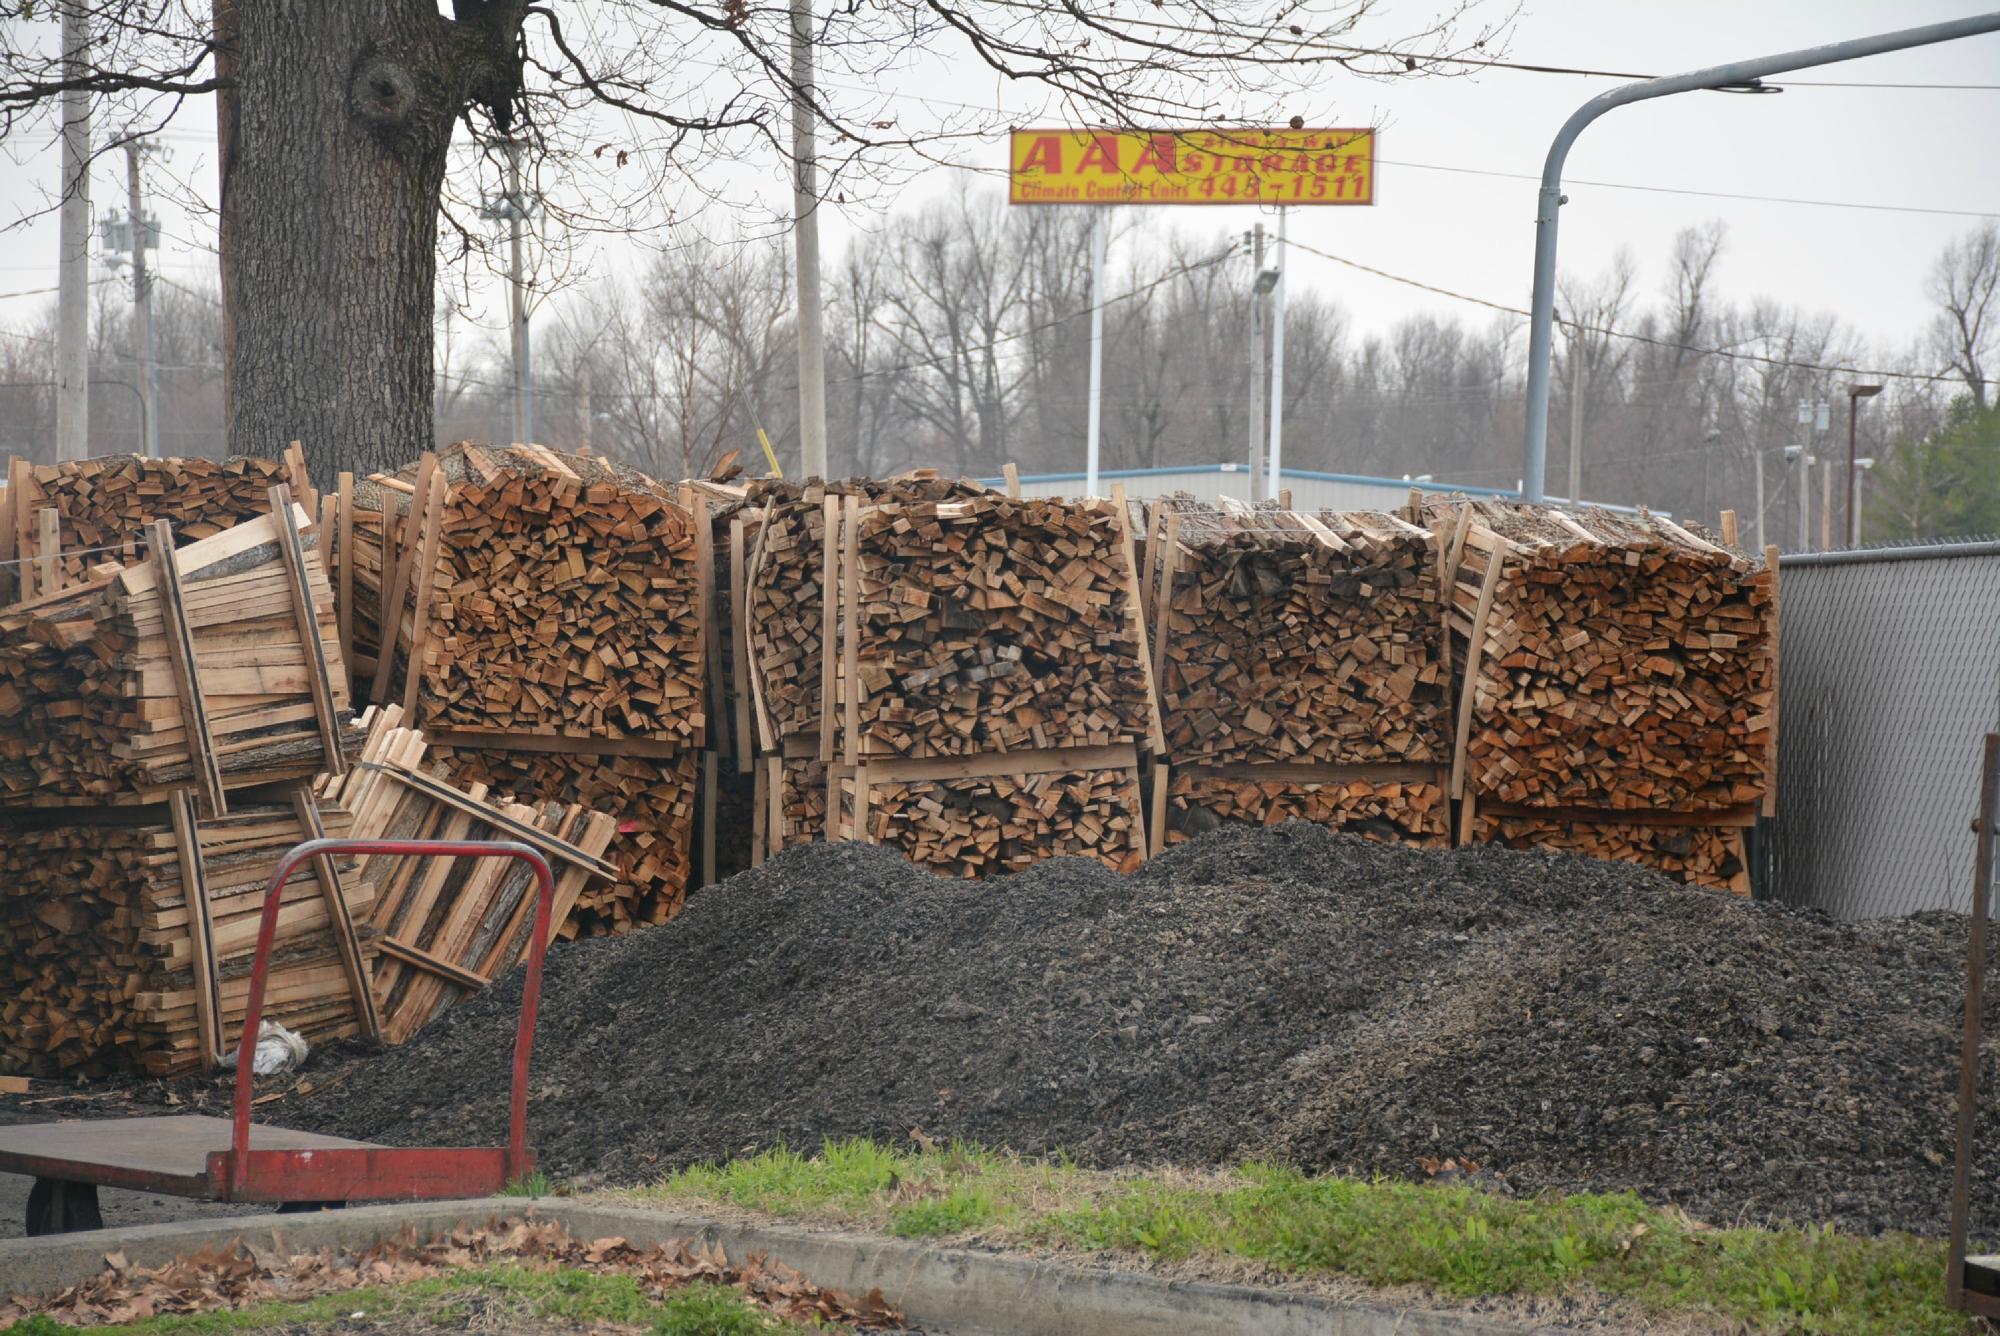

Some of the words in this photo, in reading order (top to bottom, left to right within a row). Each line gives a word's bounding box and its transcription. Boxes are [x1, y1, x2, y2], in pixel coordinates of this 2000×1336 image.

[1020, 136, 1177, 174] AAA
[1183, 154, 1366, 173] STORAGE
[1021, 180, 1079, 198] Climate
